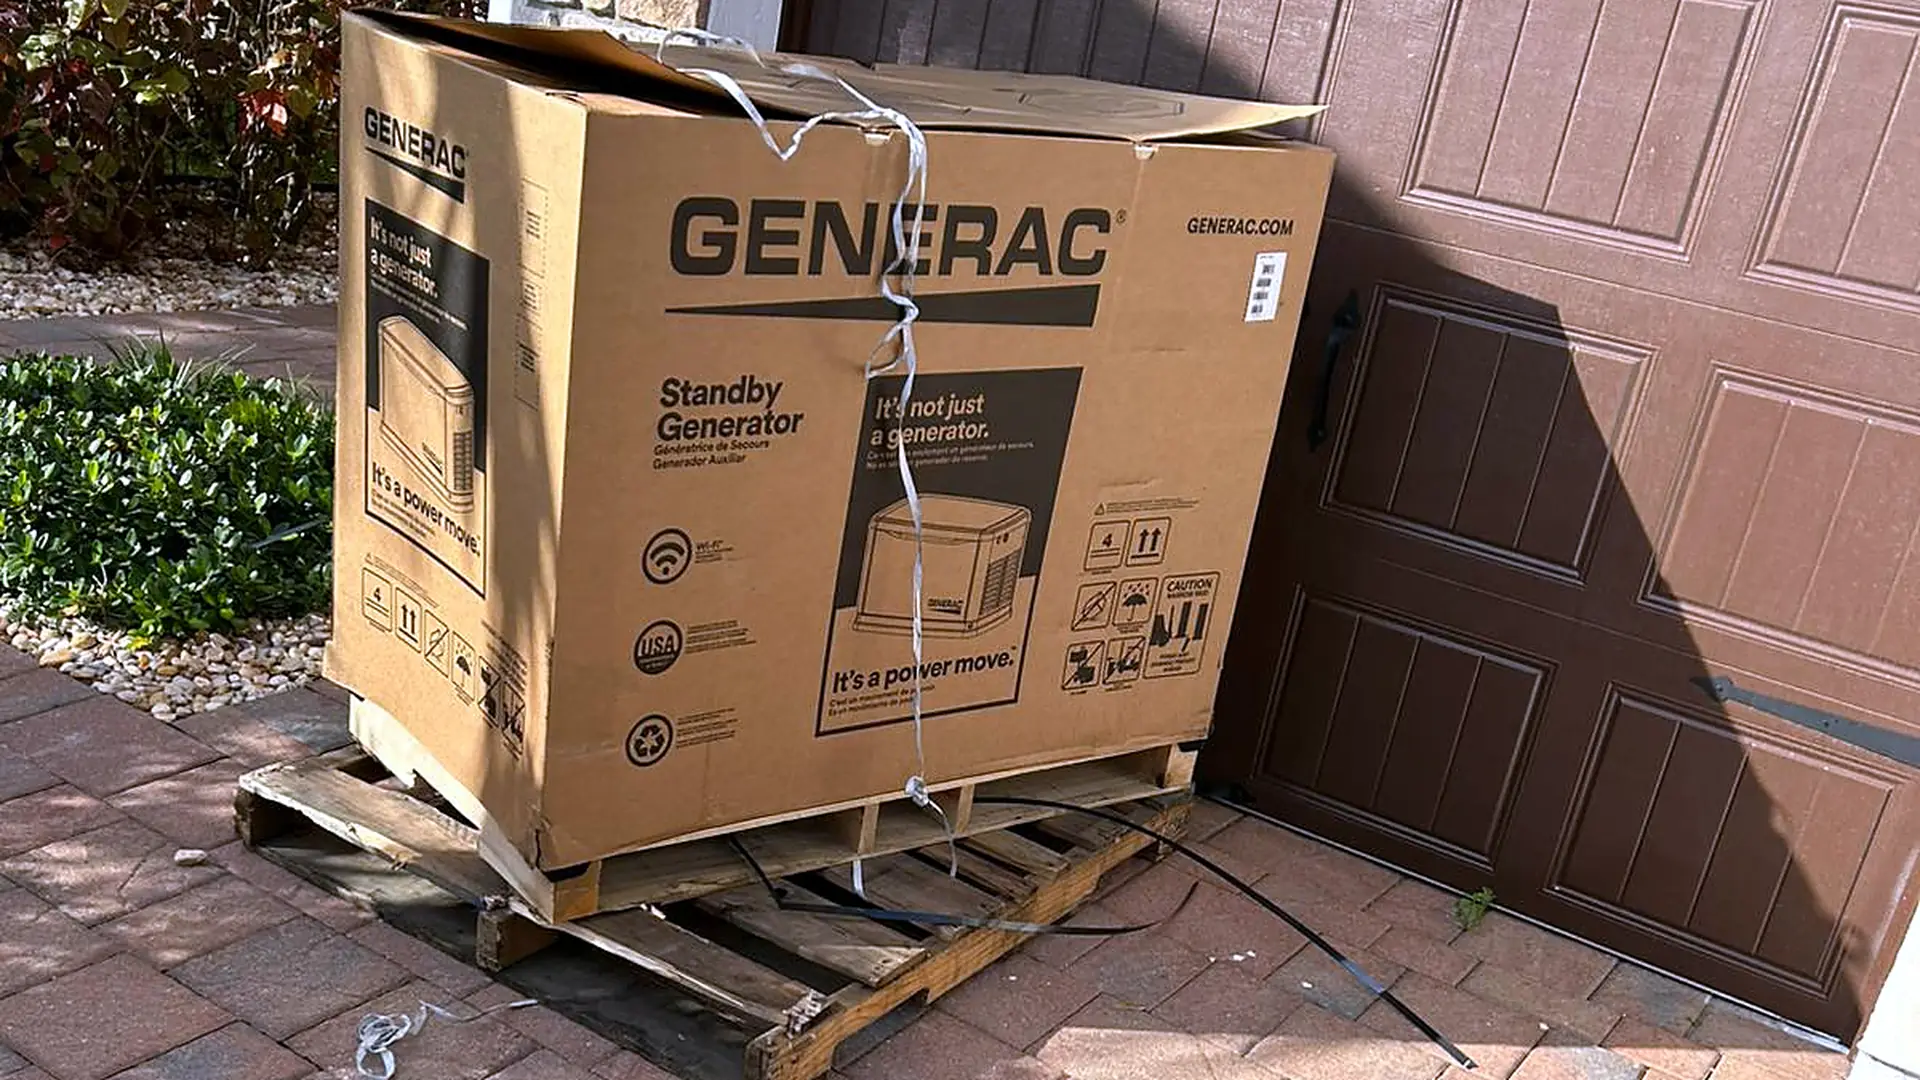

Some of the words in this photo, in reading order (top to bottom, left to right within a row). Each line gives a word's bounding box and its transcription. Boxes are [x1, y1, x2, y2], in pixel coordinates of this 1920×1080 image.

[1187, 217, 1294, 235] GENERAC.COM
[389, 232, 408, 256] not
[409, 236, 432, 269] just
[371, 248, 378, 266] a
[380, 253, 438, 299] generator.
[660, 375, 783, 409] Standby
[910, 396, 945, 418] not
[944, 393, 985, 420] just
[657, 409, 804, 442] Generator
[870, 428, 883, 446] a
[887, 420, 989, 450] generator.
[715, 441, 728, 452] de
[729, 439, 770, 451] Secours
[653, 454, 707, 470] Generador
[372, 461, 392, 492] It's
[394, 480, 401, 498] a
[404, 487, 443, 526] power
[1102, 533, 1113, 547] 4
[373, 587, 382, 602] 4
[1167, 579, 1212, 592] CAUTION
[641, 634, 674, 656] USA
[833, 669, 864, 693] It's
[867, 671, 880, 688] a
[884, 659, 953, 690] power
